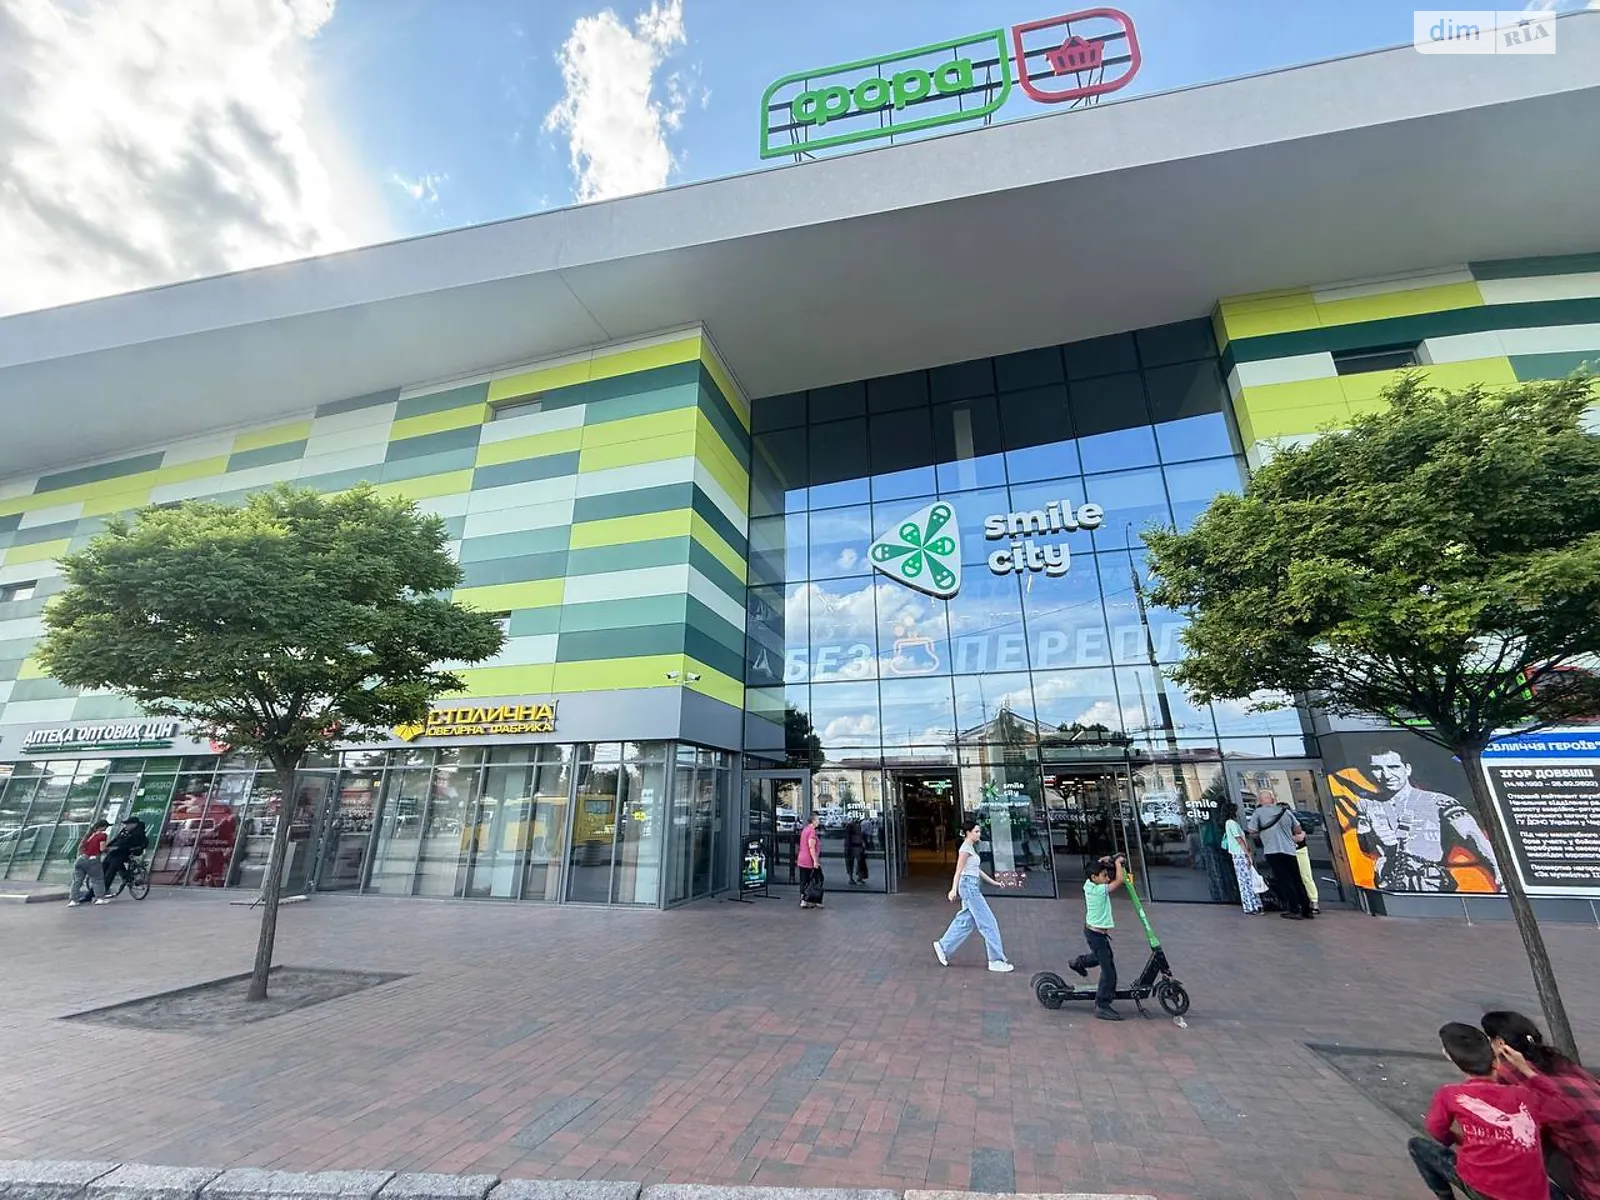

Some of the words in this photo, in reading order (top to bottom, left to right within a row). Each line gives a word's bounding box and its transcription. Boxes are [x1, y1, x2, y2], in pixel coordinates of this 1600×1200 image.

[791, 58, 975, 127] фора
[984, 499, 1105, 541] smile
[988, 538, 1071, 578] city
[784, 643, 871, 682] БЕЗ
[427, 703, 554, 725] СТОЛИЧНА
[23, 726, 74, 746] АПТЕКА
[76, 723, 142, 743] ОПТОВИХ
[143, 722, 176, 740] ЦІН
[489, 721, 554, 734] ФАБРИКА
[1184, 799, 1218, 809] smile
[1186, 808, 1210, 821] city
